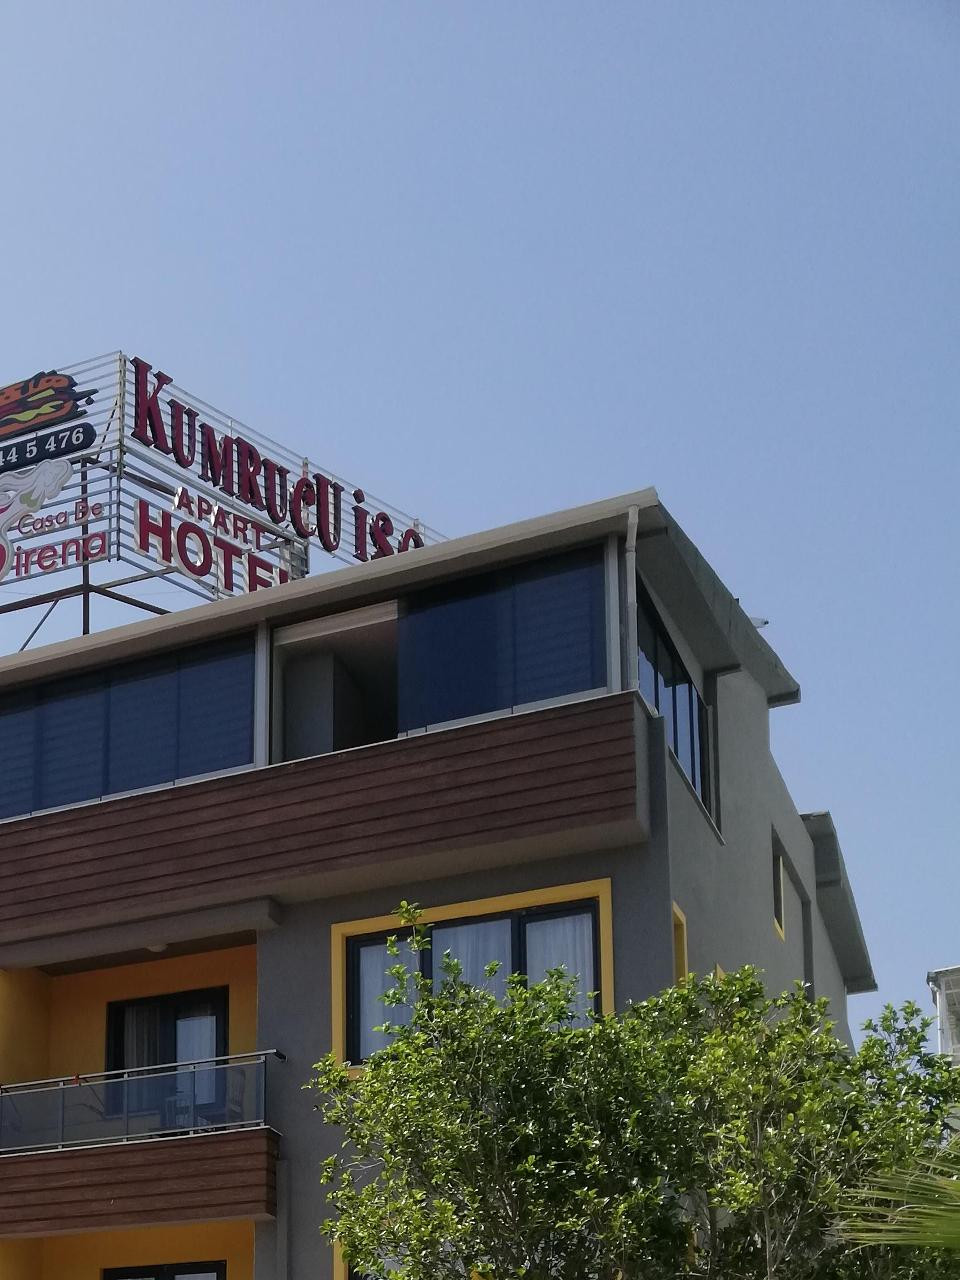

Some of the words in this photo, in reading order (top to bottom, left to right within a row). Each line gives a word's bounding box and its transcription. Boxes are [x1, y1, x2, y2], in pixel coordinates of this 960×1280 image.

[26, 440, 38, 459] 5
[45, 427, 84, 452] 476
[131, 356, 344, 551] KUMRUCU
[17, 510, 68, 536] Casa
[134, 499, 290, 594] HOTE
[174, 486, 267, 551] APART
